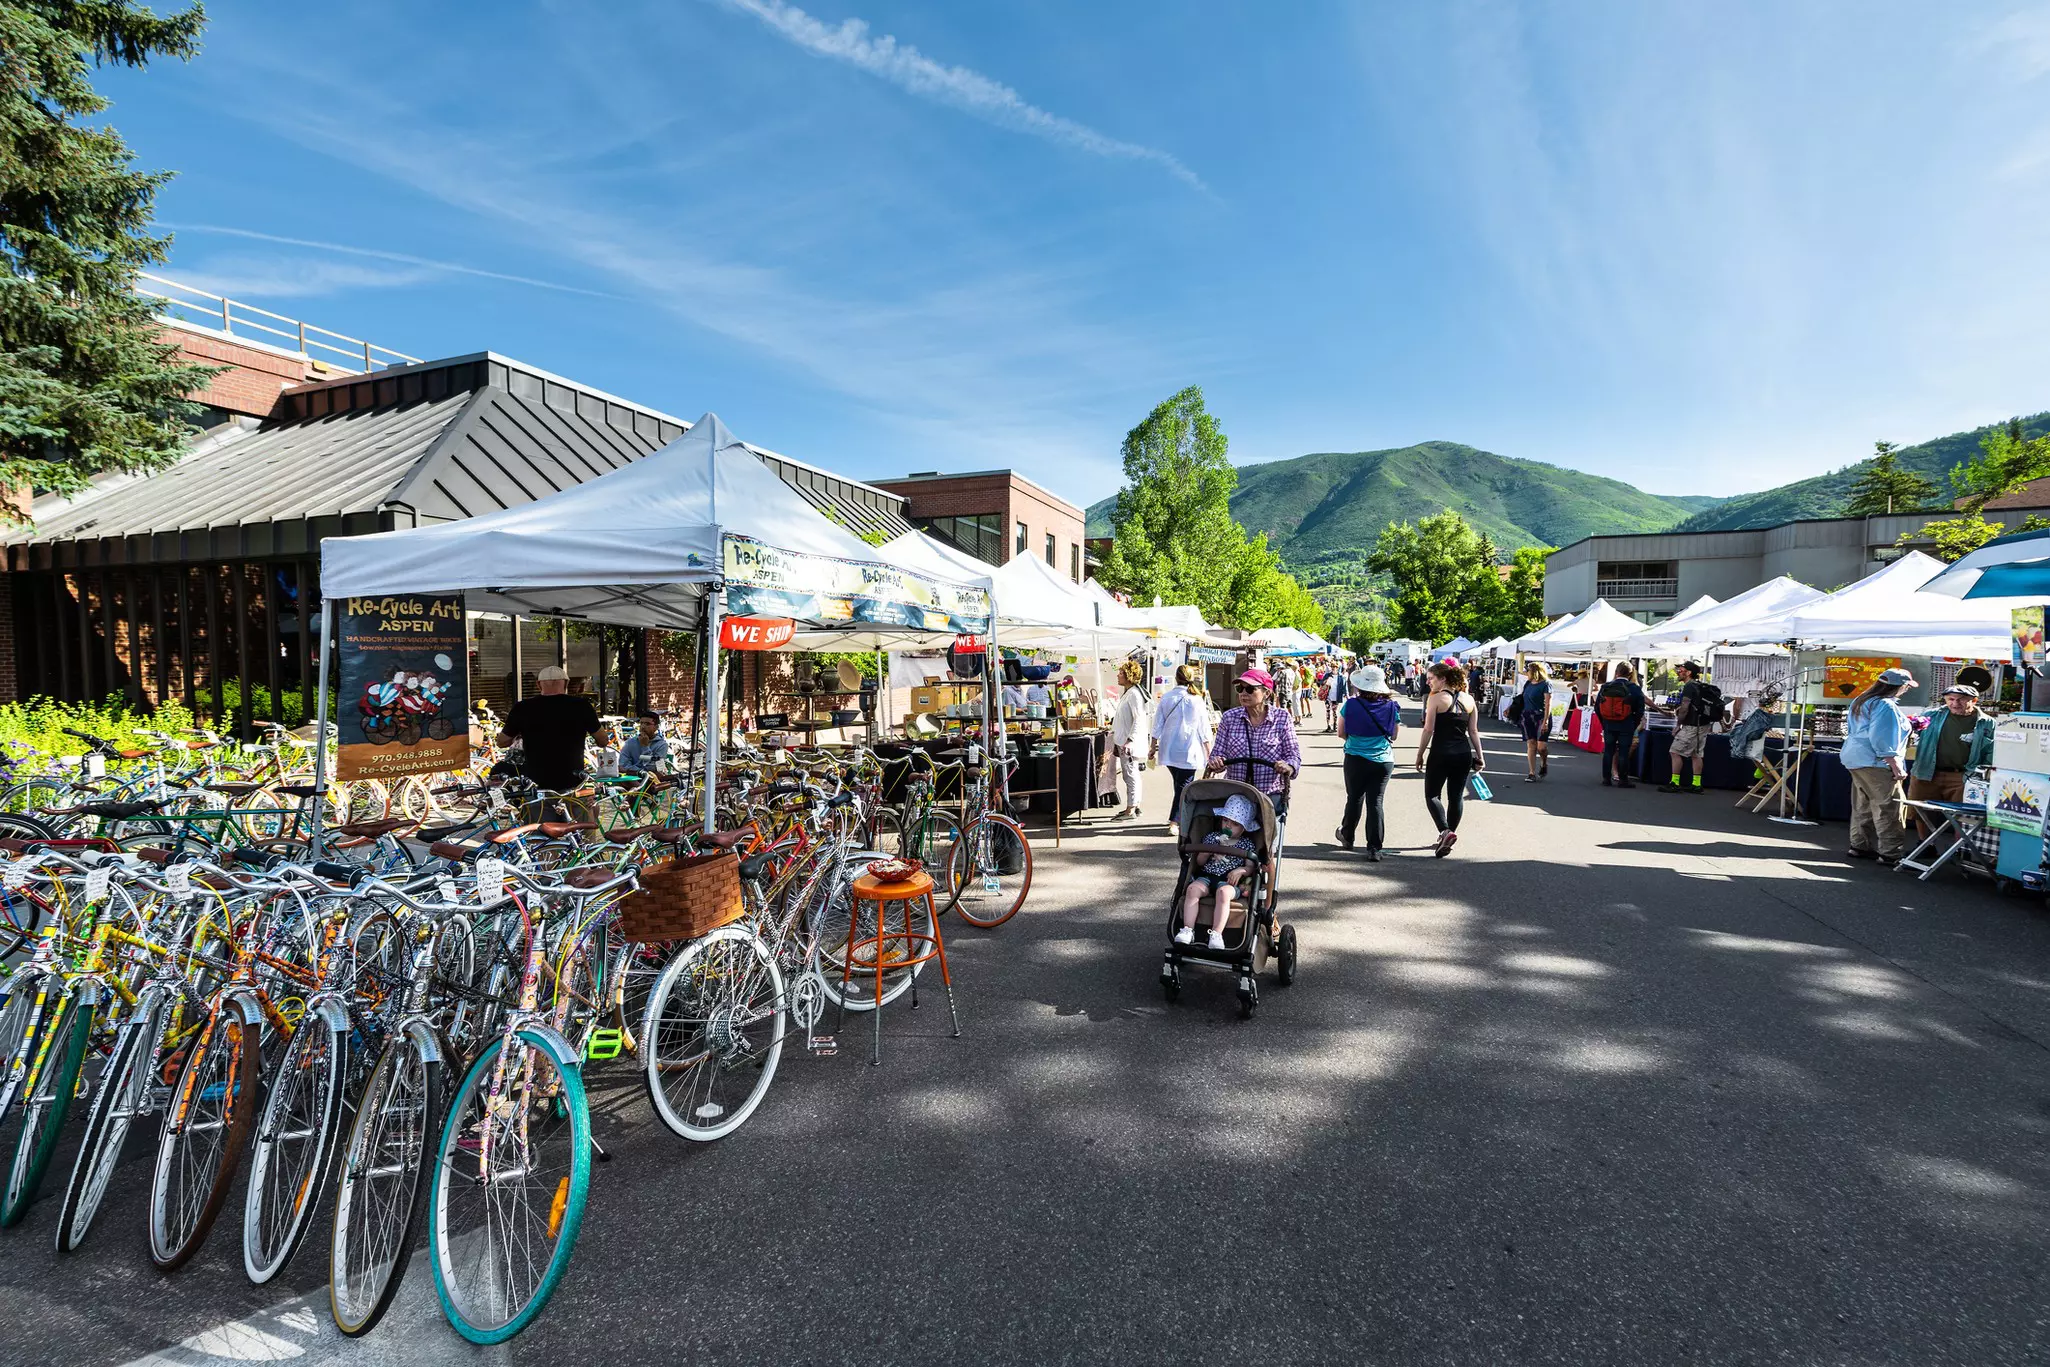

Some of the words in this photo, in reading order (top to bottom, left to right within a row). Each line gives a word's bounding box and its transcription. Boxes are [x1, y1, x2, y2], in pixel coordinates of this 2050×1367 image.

[734, 544, 779, 569] Re-Cycle
[753, 569, 785, 583] ASPEN
[348, 597, 424, 619] Re-Cycle
[430, 600, 461, 620] Art
[378, 620, 434, 632] ASPEN
[731, 624, 760, 643] WE
[957, 635, 972, 647] WE
[371, 748, 443, 763] 970.948.9888
[359, 758, 455, 774] Re-CycleArt.com
